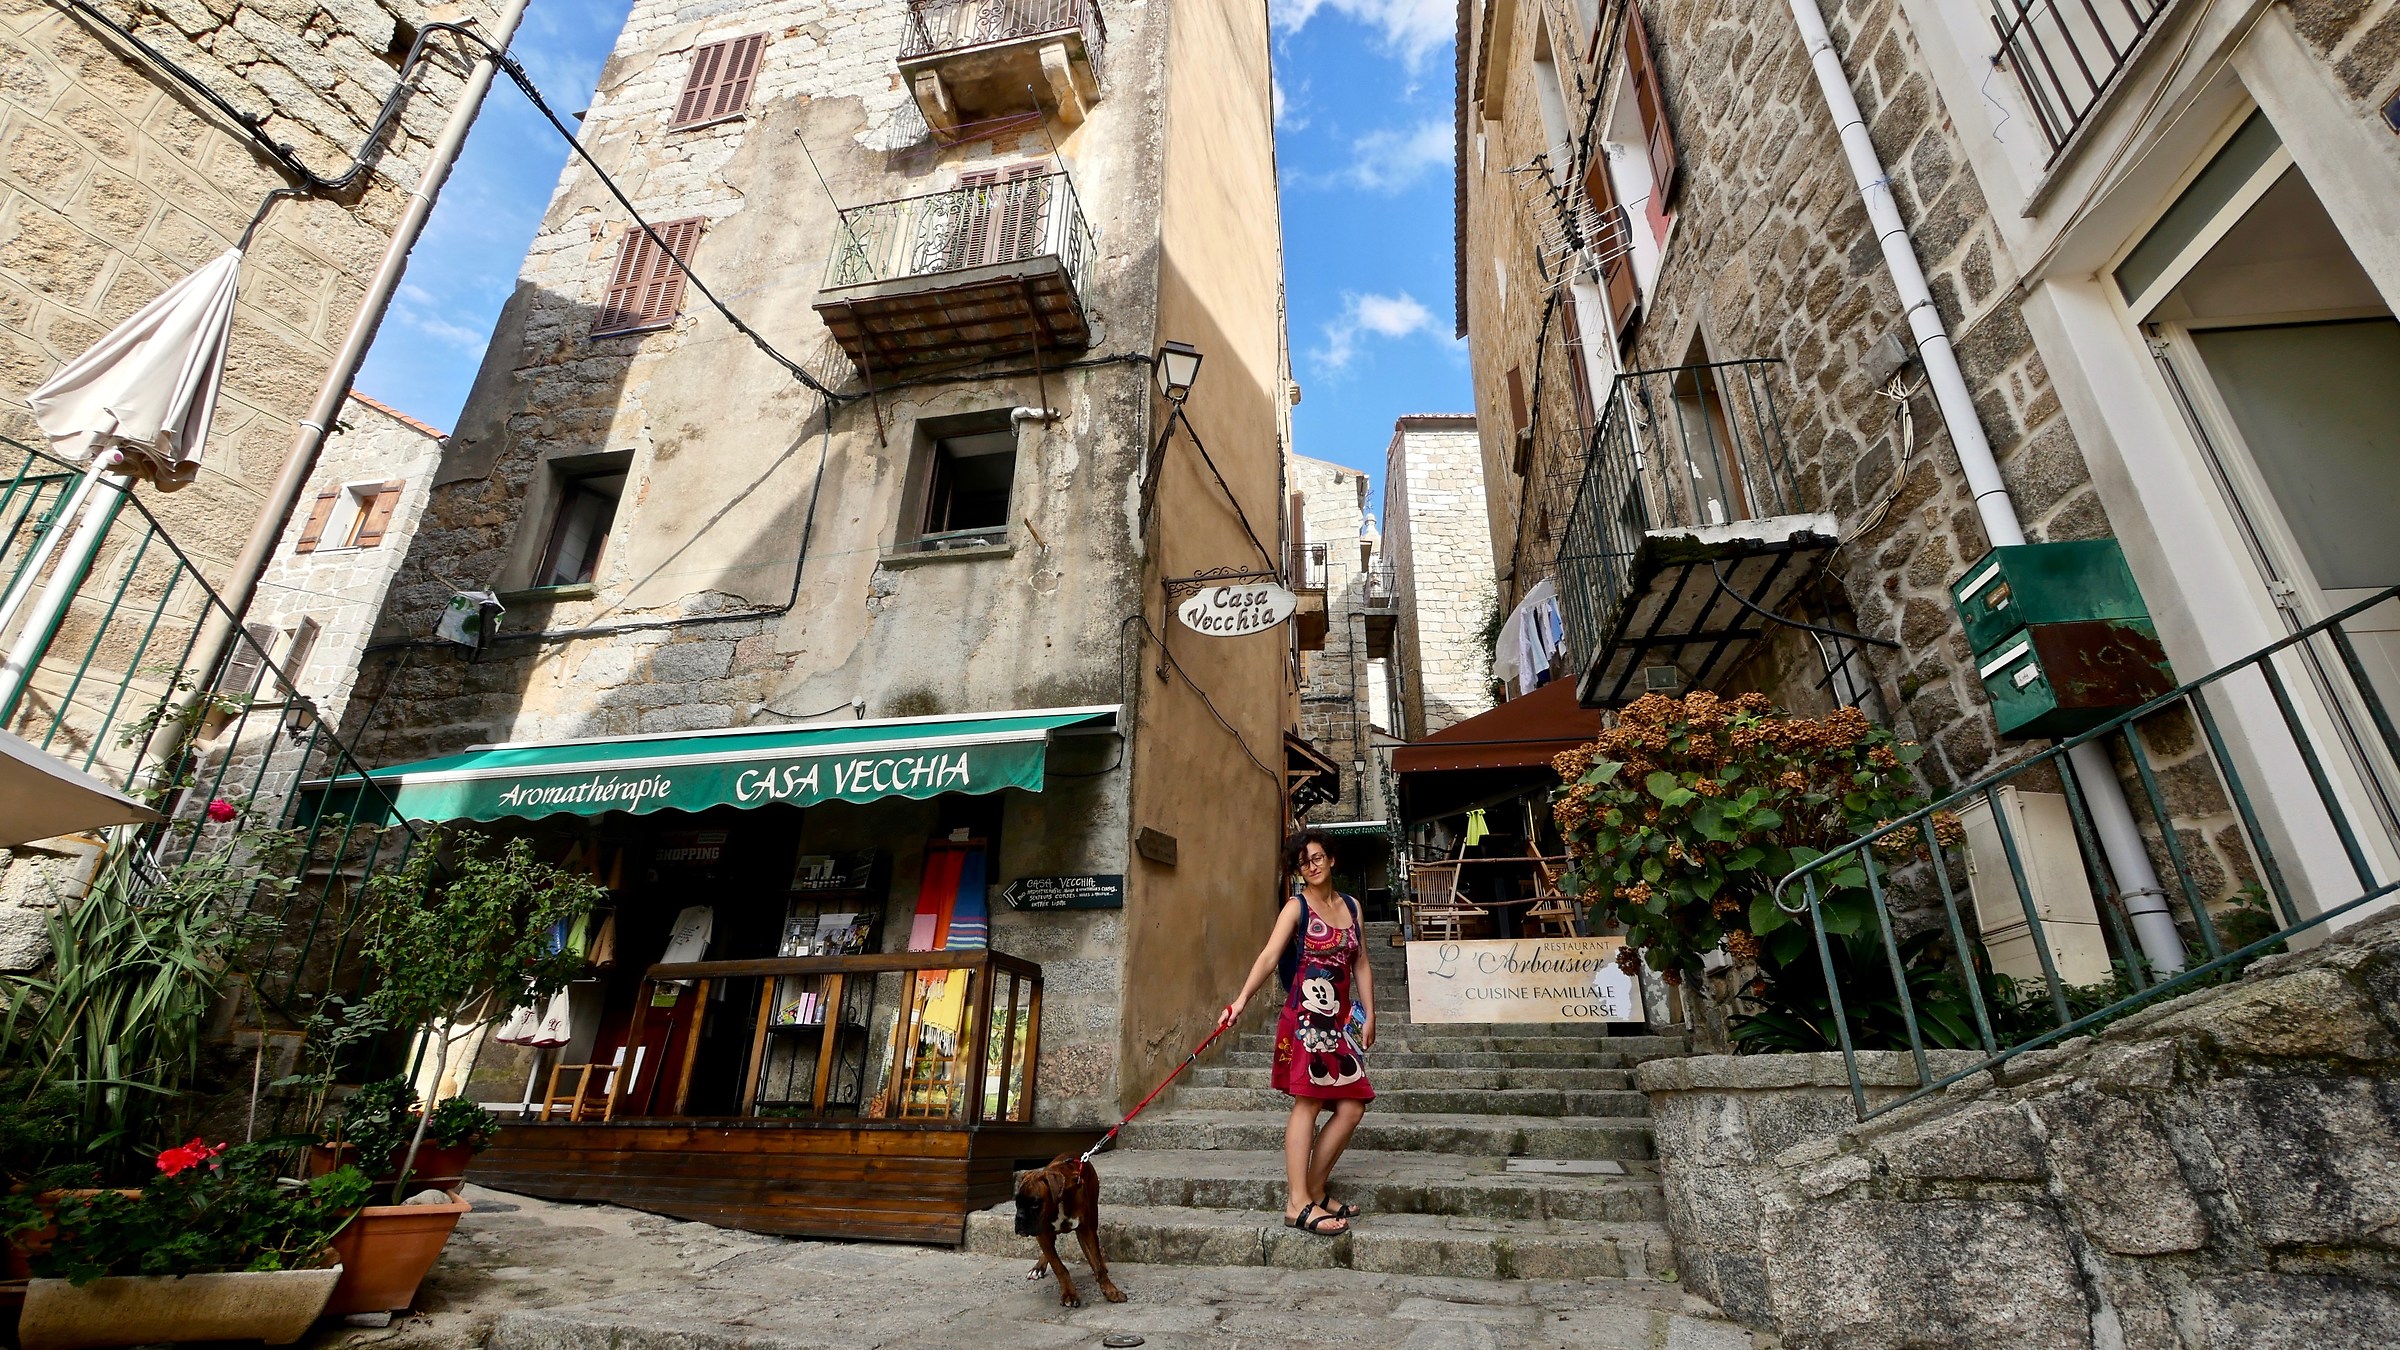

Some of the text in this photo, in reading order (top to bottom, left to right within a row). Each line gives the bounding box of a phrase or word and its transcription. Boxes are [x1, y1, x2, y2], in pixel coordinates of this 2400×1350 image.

[1213, 586, 1268, 608] Casa
[735, 751, 970, 801] CASA VECCHIA
[498, 774, 672, 813] Aromathérapie
[655, 847, 720, 861] SHOPPING
[1026, 877, 1096, 889] CASA VECCHIA
[1543, 941, 1609, 951] RESTAURANT
[1465, 985, 1615, 1000] CUISINE FAMILIALE
[1561, 1004, 1618, 1018] CORSE
